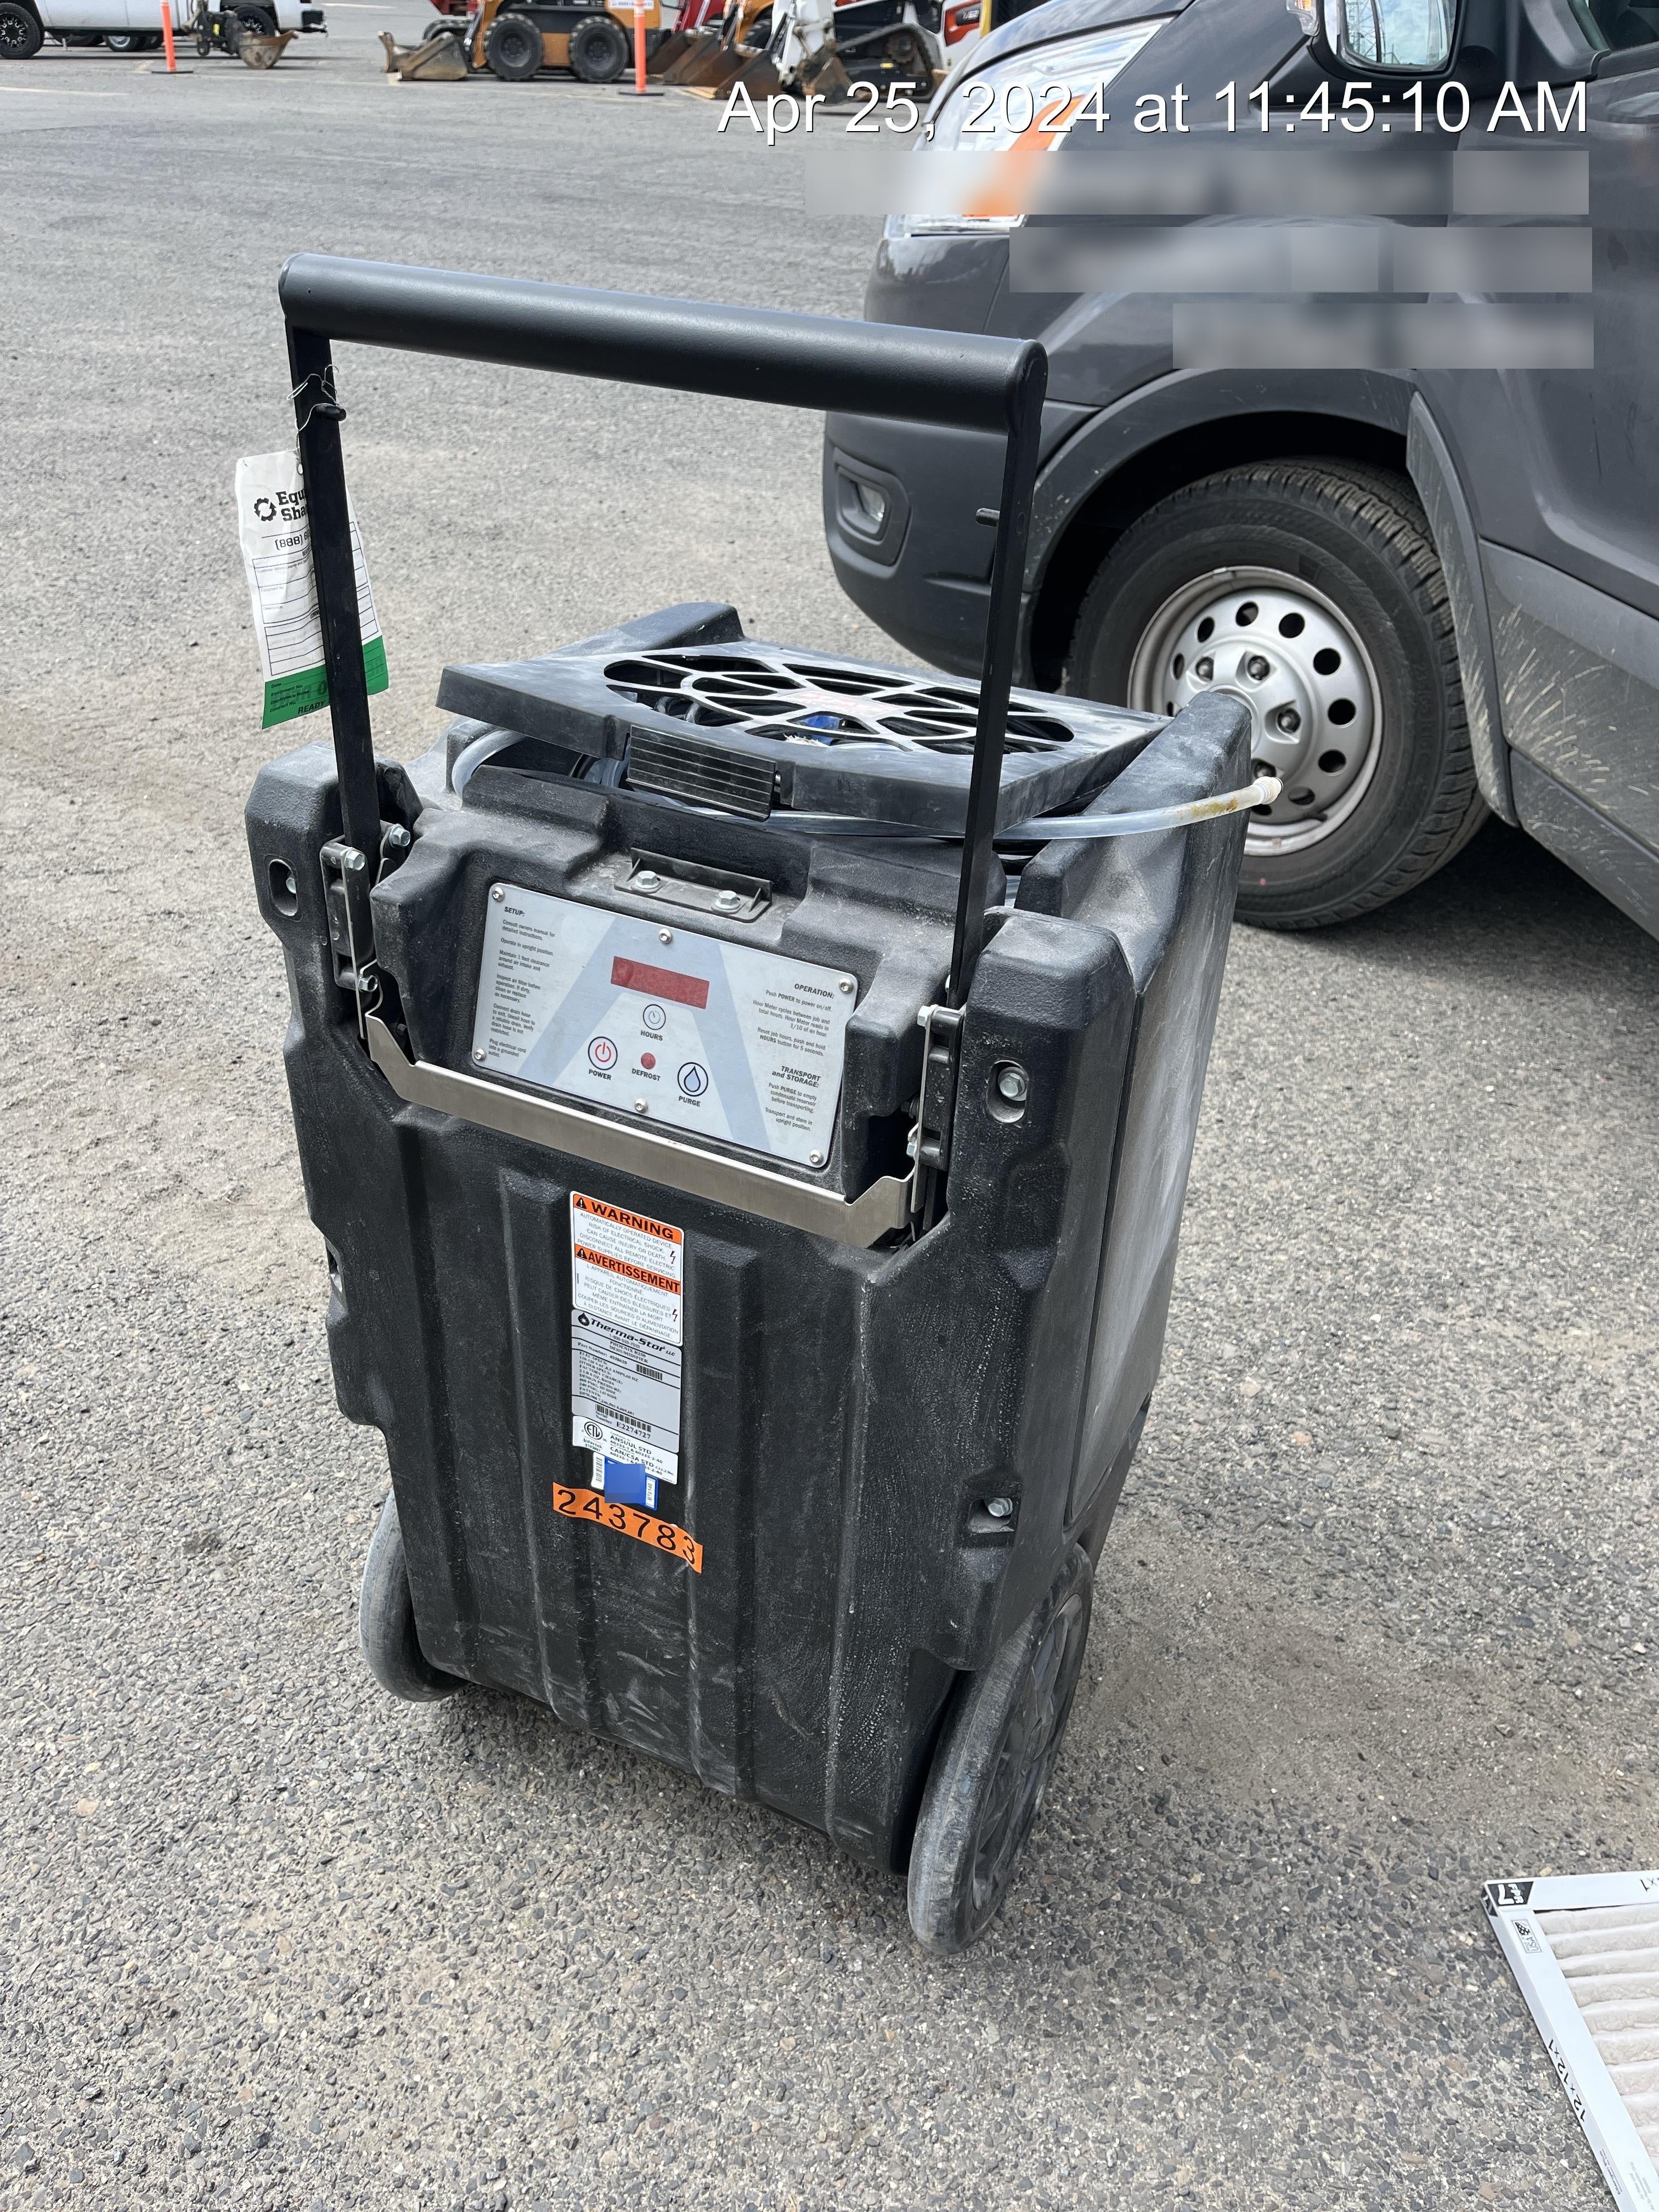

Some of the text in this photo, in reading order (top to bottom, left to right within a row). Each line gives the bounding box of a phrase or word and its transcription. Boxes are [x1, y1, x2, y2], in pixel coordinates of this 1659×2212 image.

[281, 504, 308, 522] Sha
[275, 534, 303, 550] (888)
[298, 699, 326, 714] READY
[504, 906, 525, 917] SETUP:
[794, 983, 834, 998] OPERATION:
[764, 1002, 777, 1011] Meter
[778, 1006, 792, 1015] cycles
[793, 1010, 811, 1019] between
[778, 993, 795, 1002] POWER
[801, 1000, 815, 1008] power
[816, 1003, 832, 1013] on/off.
[770, 1011, 783, 1019] hours.
[810, 1021, 823, 1029] reads
[790, 1023, 802, 1031] 1/10
[640, 1030, 663, 1041] HOURS
[779, 1033, 793, 1042] hours,
[793, 1037, 805, 1045] push
[760, 1034, 776, 1043] HOURS
[804, 1047, 825, 1056] seconds.
[588, 1069, 611, 1080] POWER
[631, 1068, 661, 1081] DEFROST
[771, 1070, 819, 1088] and STORAGE:
[781, 1065, 820, 1082] TRANSPORT
[678, 1096, 701, 1107] PURGE
[770, 1090, 816, 1107] condensate reservoir
[780, 1086, 797, 1094] PURGE
[803, 1093, 817, 1102] empty
[764, 1107, 785, 1118] Transport
[786, 1101, 815, 1114] transporting.
[775, 1117, 811, 1132] upright position.
[580, 1212, 621, 1231] AUTOMATICALLY
[623, 1227, 651, 1242] OPERATED
[591, 1201, 673, 1240] WARNING
[586, 1228, 597, 1237] CAN
[599, 1232, 616, 1243] CAUSE
[618, 1239, 636, 1250] INJURY
[589, 1222, 600, 1231] RISK
[611, 1230, 642, 1245] ELECTRICAL
[577, 1238, 595, 1249] POWER
[597, 1245, 622, 1259] SUPPLIES
[624, 1255, 644, 1267] BEFORE
[580, 1233, 675, 1271] DISCONNECT ALL REMOTE ELECTRIC
[588, 1250, 679, 1293] AVERTISSEMENT
[585, 1276, 603, 1287] RISQUE
[614, 1286, 632, 1297] CHOCS
[616, 1274, 668, 1297] AUTOMATIQUEMENT
[578, 1293, 634, 1318] COUPER LES SOURCES
[584, 1282, 596, 1291] PEUT
[599, 1288, 618, 1300] CAUSER
[620, 1295, 630, 1304] DES
[632, 1300, 663, 1316] BLESSURES
[588, 1303, 612, 1317] DISTANCE
[614, 1313, 630, 1323] AVANT
[591, 1318, 664, 1352] Therma-Stor
[589, 1346, 607, 1357] Number:
[609, 1345, 647, 1363] DEHUMIDIFIER
[610, 1340, 633, 1353] PHOENIX
[616, 1421, 650, 1440] E2274727
[610, 1434, 636, 1449] ANSI/UL
[639, 1446, 651, 1454] STD
[610, 1446, 639, 1462] CAN/CSA
[641, 1458, 653, 1468] STD
[558, 1489, 695, 1565] 243783
[1498, 1883, 1515, 1905] 7
[1508, 1883, 1524, 1904] FPR
[1549, 2038, 1585, 2123] 12x12x1
